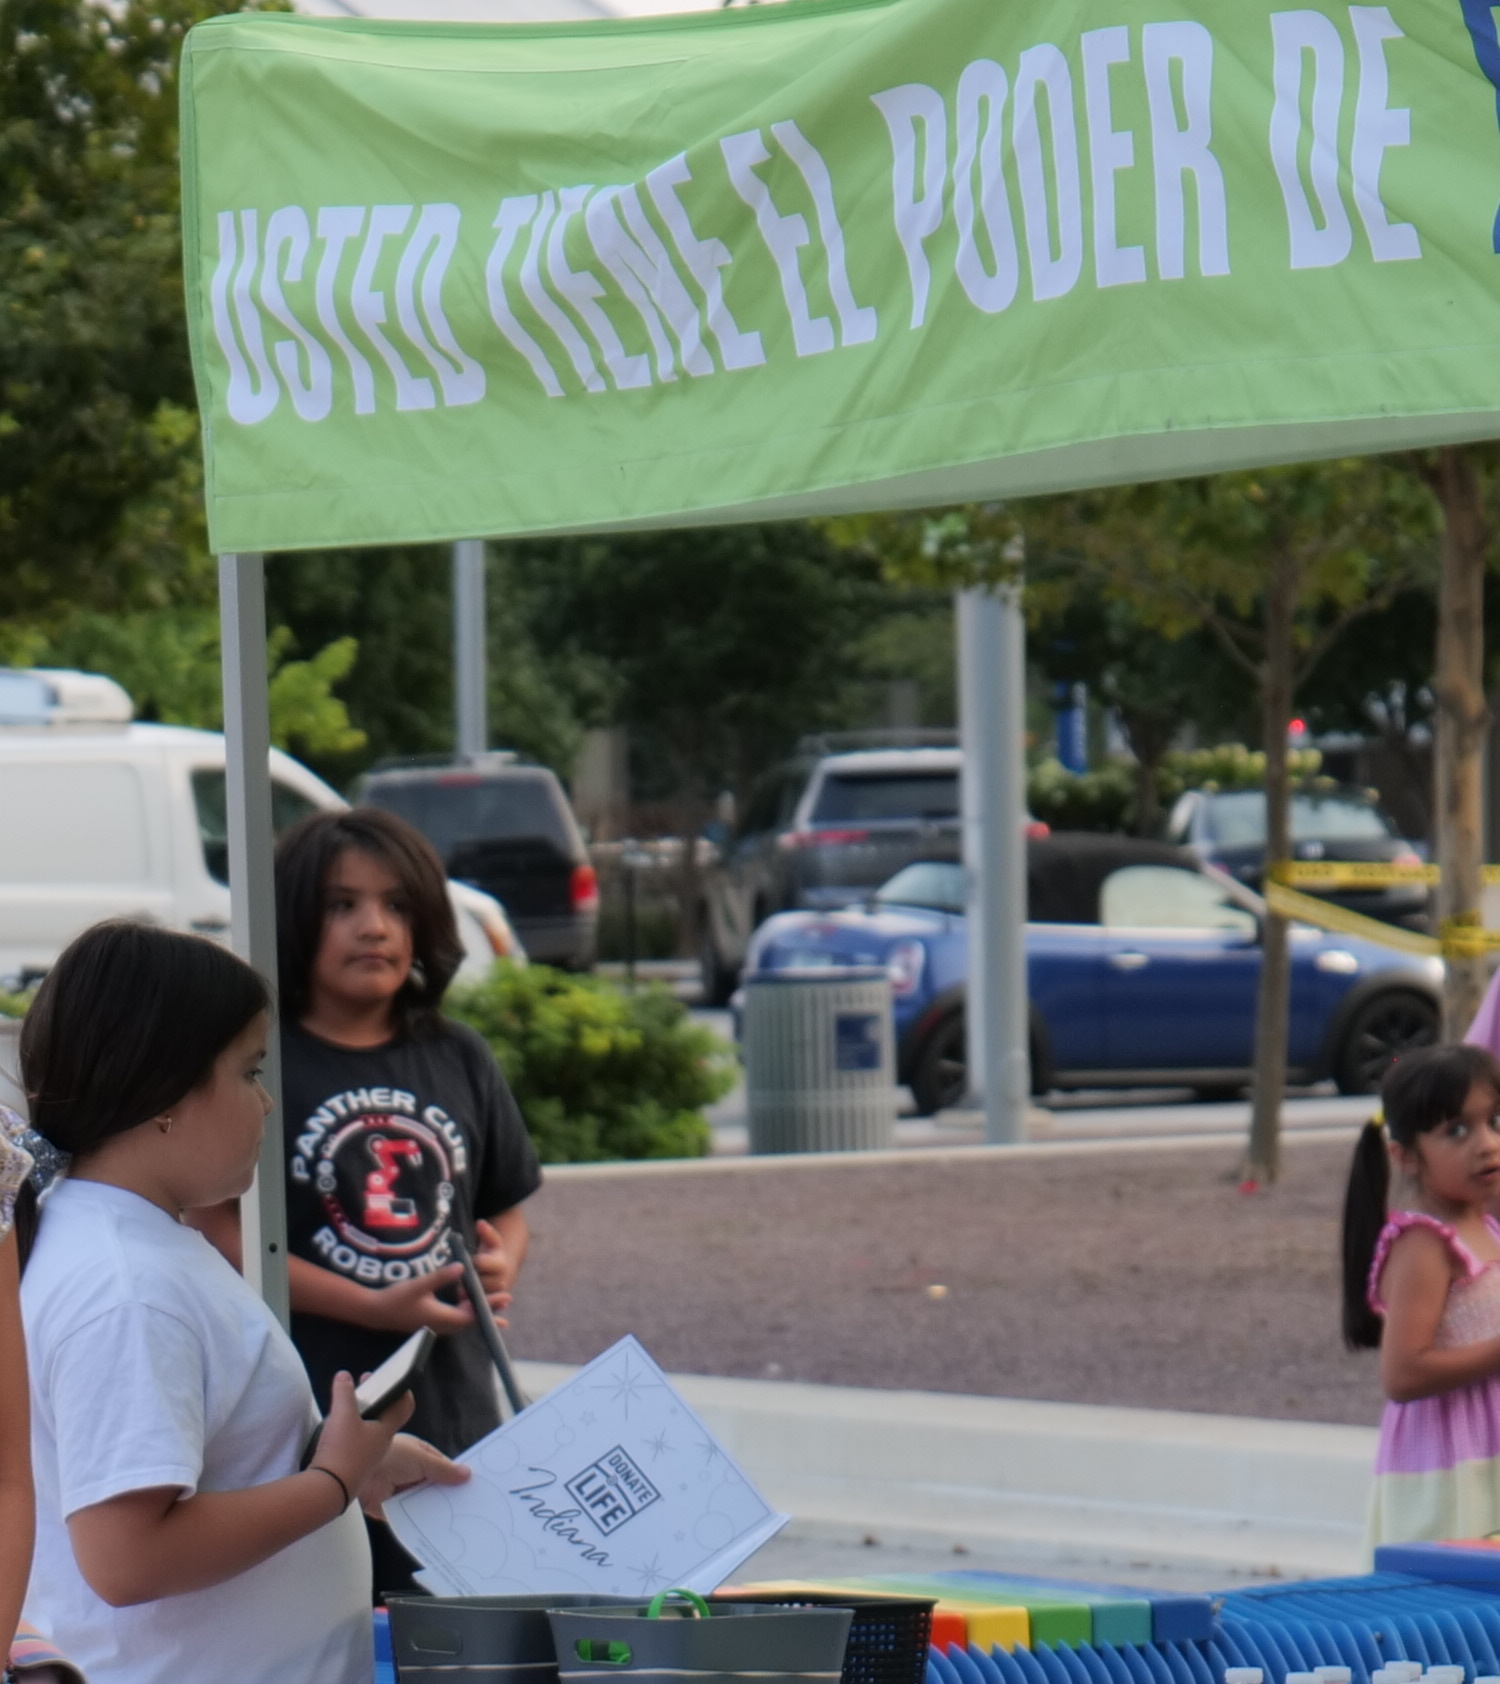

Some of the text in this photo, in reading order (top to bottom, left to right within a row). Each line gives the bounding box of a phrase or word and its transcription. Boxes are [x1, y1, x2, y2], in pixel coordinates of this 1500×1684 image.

[211, 202, 486, 425] USTED
[487, 150, 766, 399] TIENE
[720, 117, 878, 358] EL
[868, 19, 1230, 330] PODER
[1268, 4, 1422, 270] DE
[290, 1087, 417, 1182] PANTHER
[509, 1467, 614, 1568] Indiana
[576, 1471, 627, 1528] LIFE
[608, 1453, 653, 1505] DONATE
